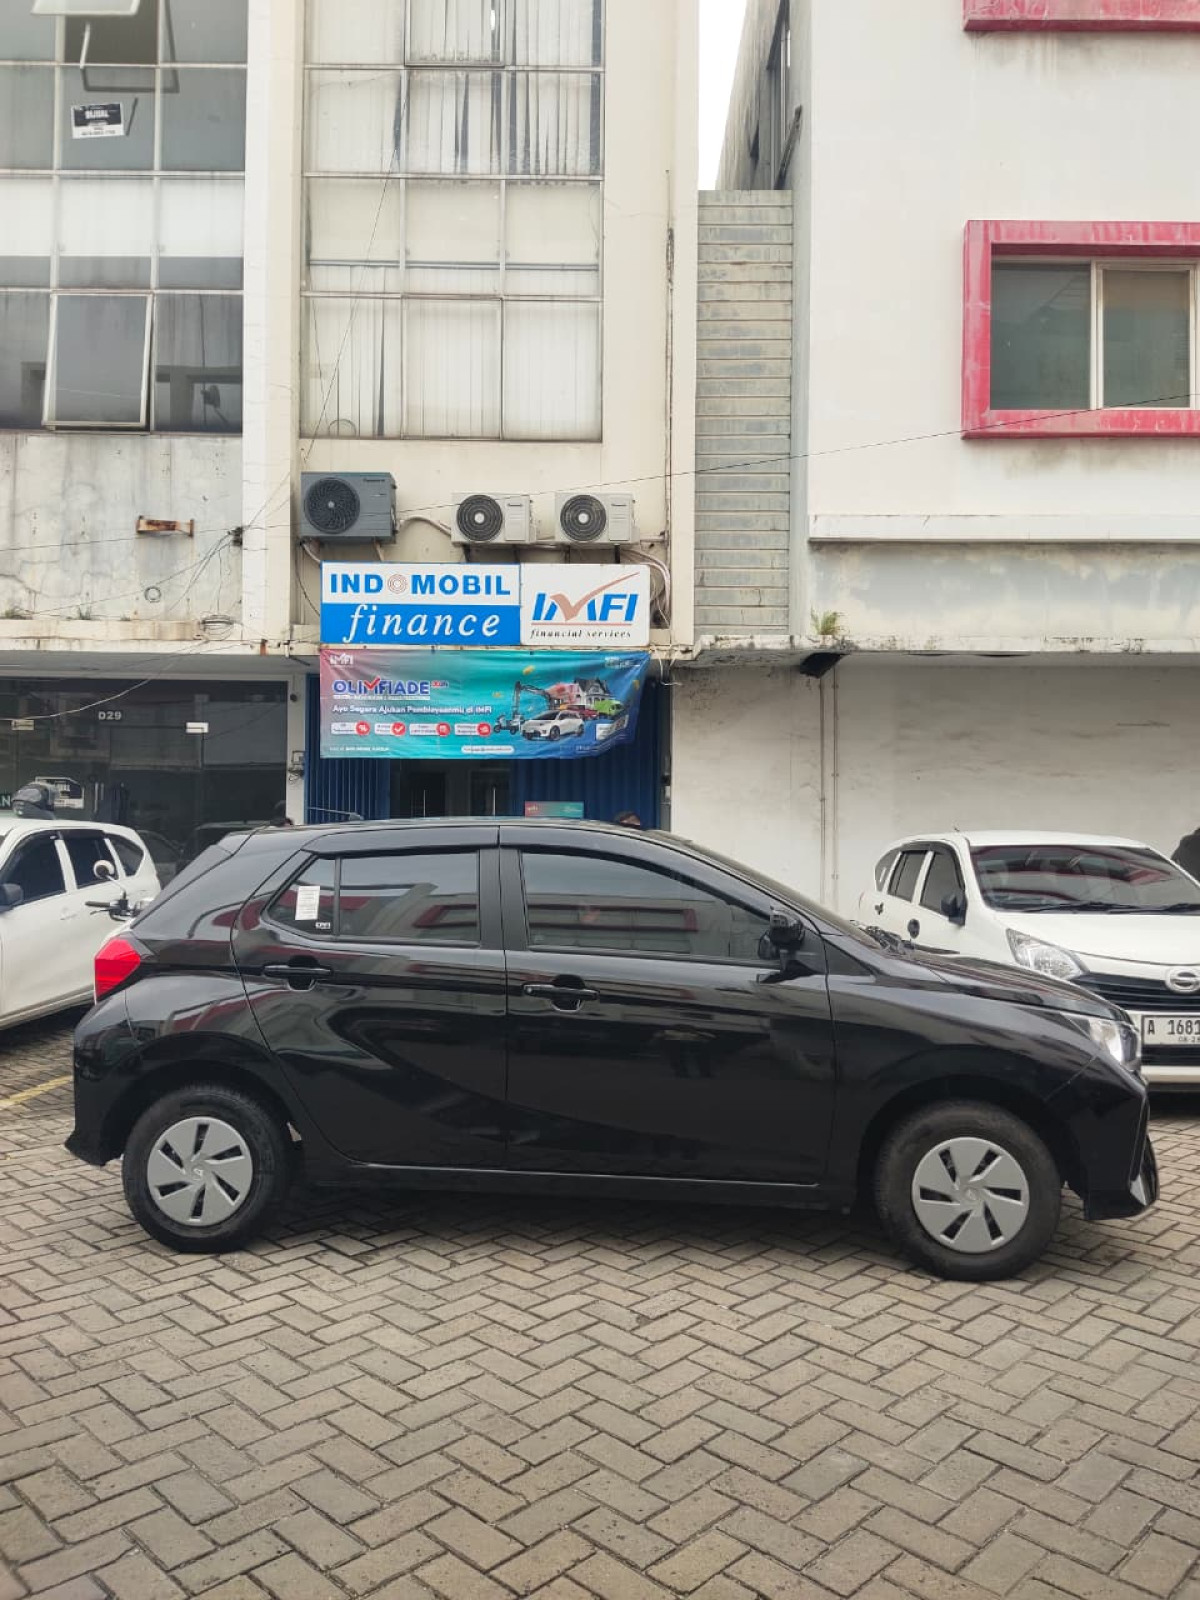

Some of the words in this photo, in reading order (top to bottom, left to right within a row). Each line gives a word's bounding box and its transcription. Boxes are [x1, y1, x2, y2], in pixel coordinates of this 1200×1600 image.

[330, 573, 511, 596] INDOMOBIL
[342, 605, 500, 642] finance
[530, 629, 583, 639] financial
[587, 629, 632, 638] services
[333, 677, 430, 695] OLIMFIADE
[98, 710, 122, 721] D29
[1147, 1019, 1155, 1035] A
